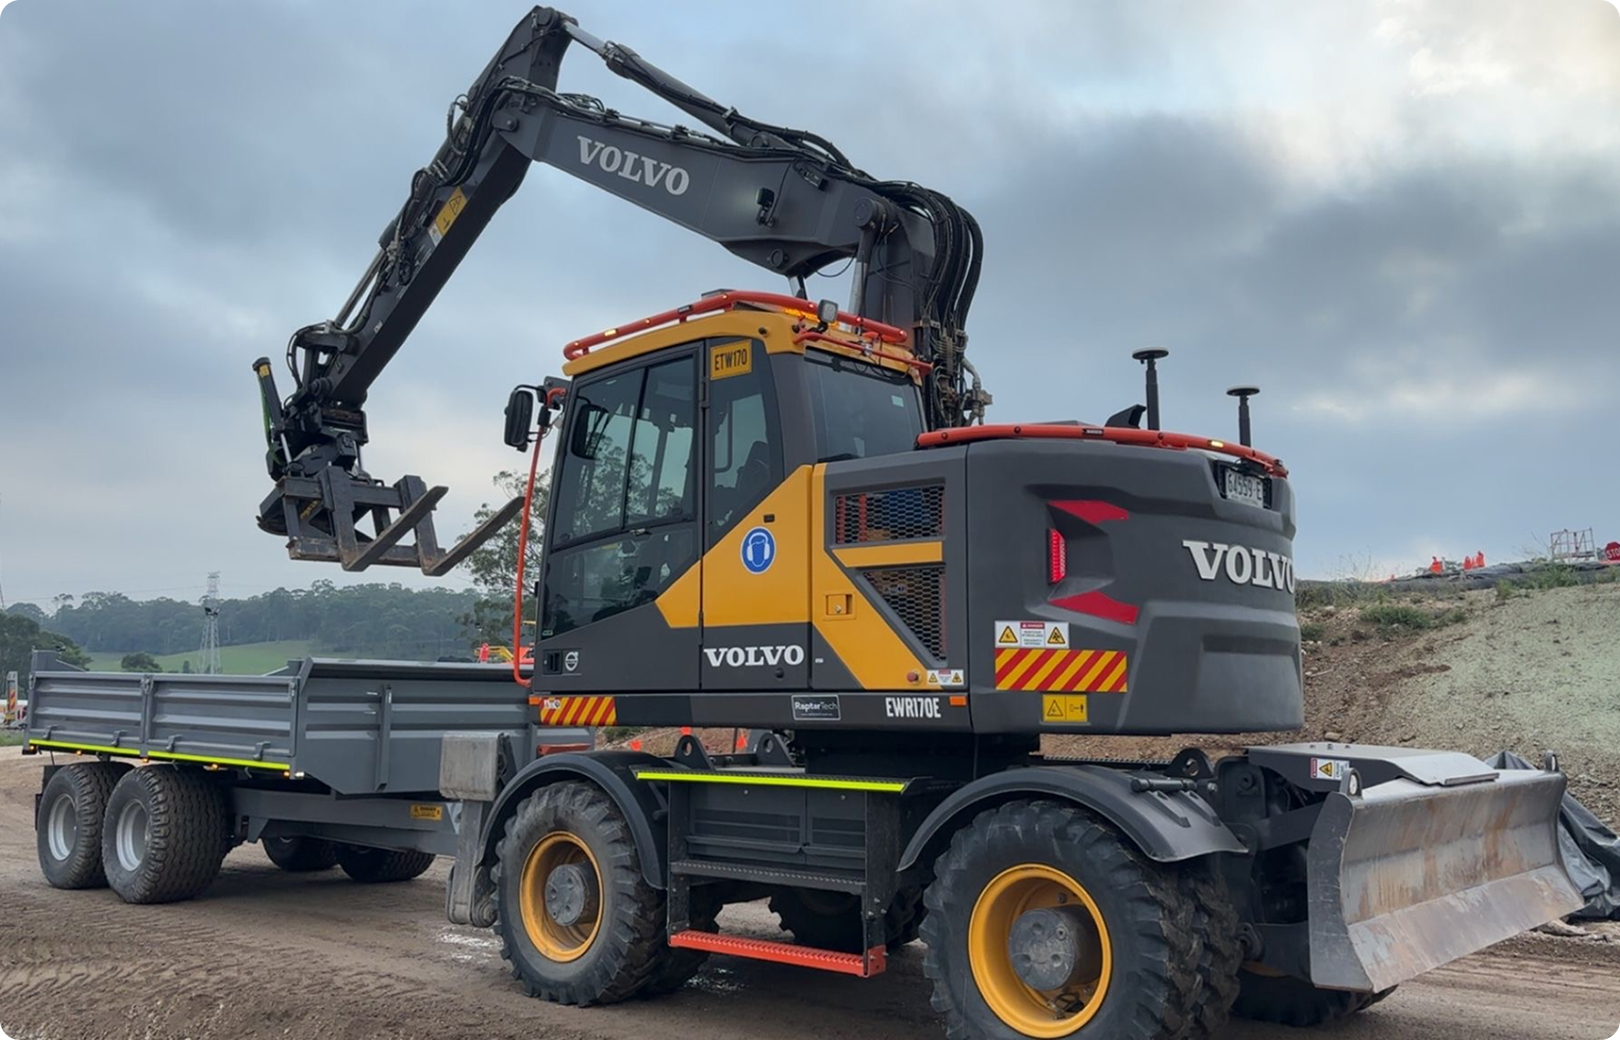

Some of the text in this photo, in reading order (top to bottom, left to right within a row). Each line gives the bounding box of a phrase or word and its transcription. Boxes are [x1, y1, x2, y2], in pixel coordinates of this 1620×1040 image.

[577, 135, 690, 196] VOLVO
[714, 348, 748, 371] ETW170
[1606, 546, 1620, 559] STO
[703, 645, 804, 667] VOLVO
[885, 697, 942, 718] EWR170E
